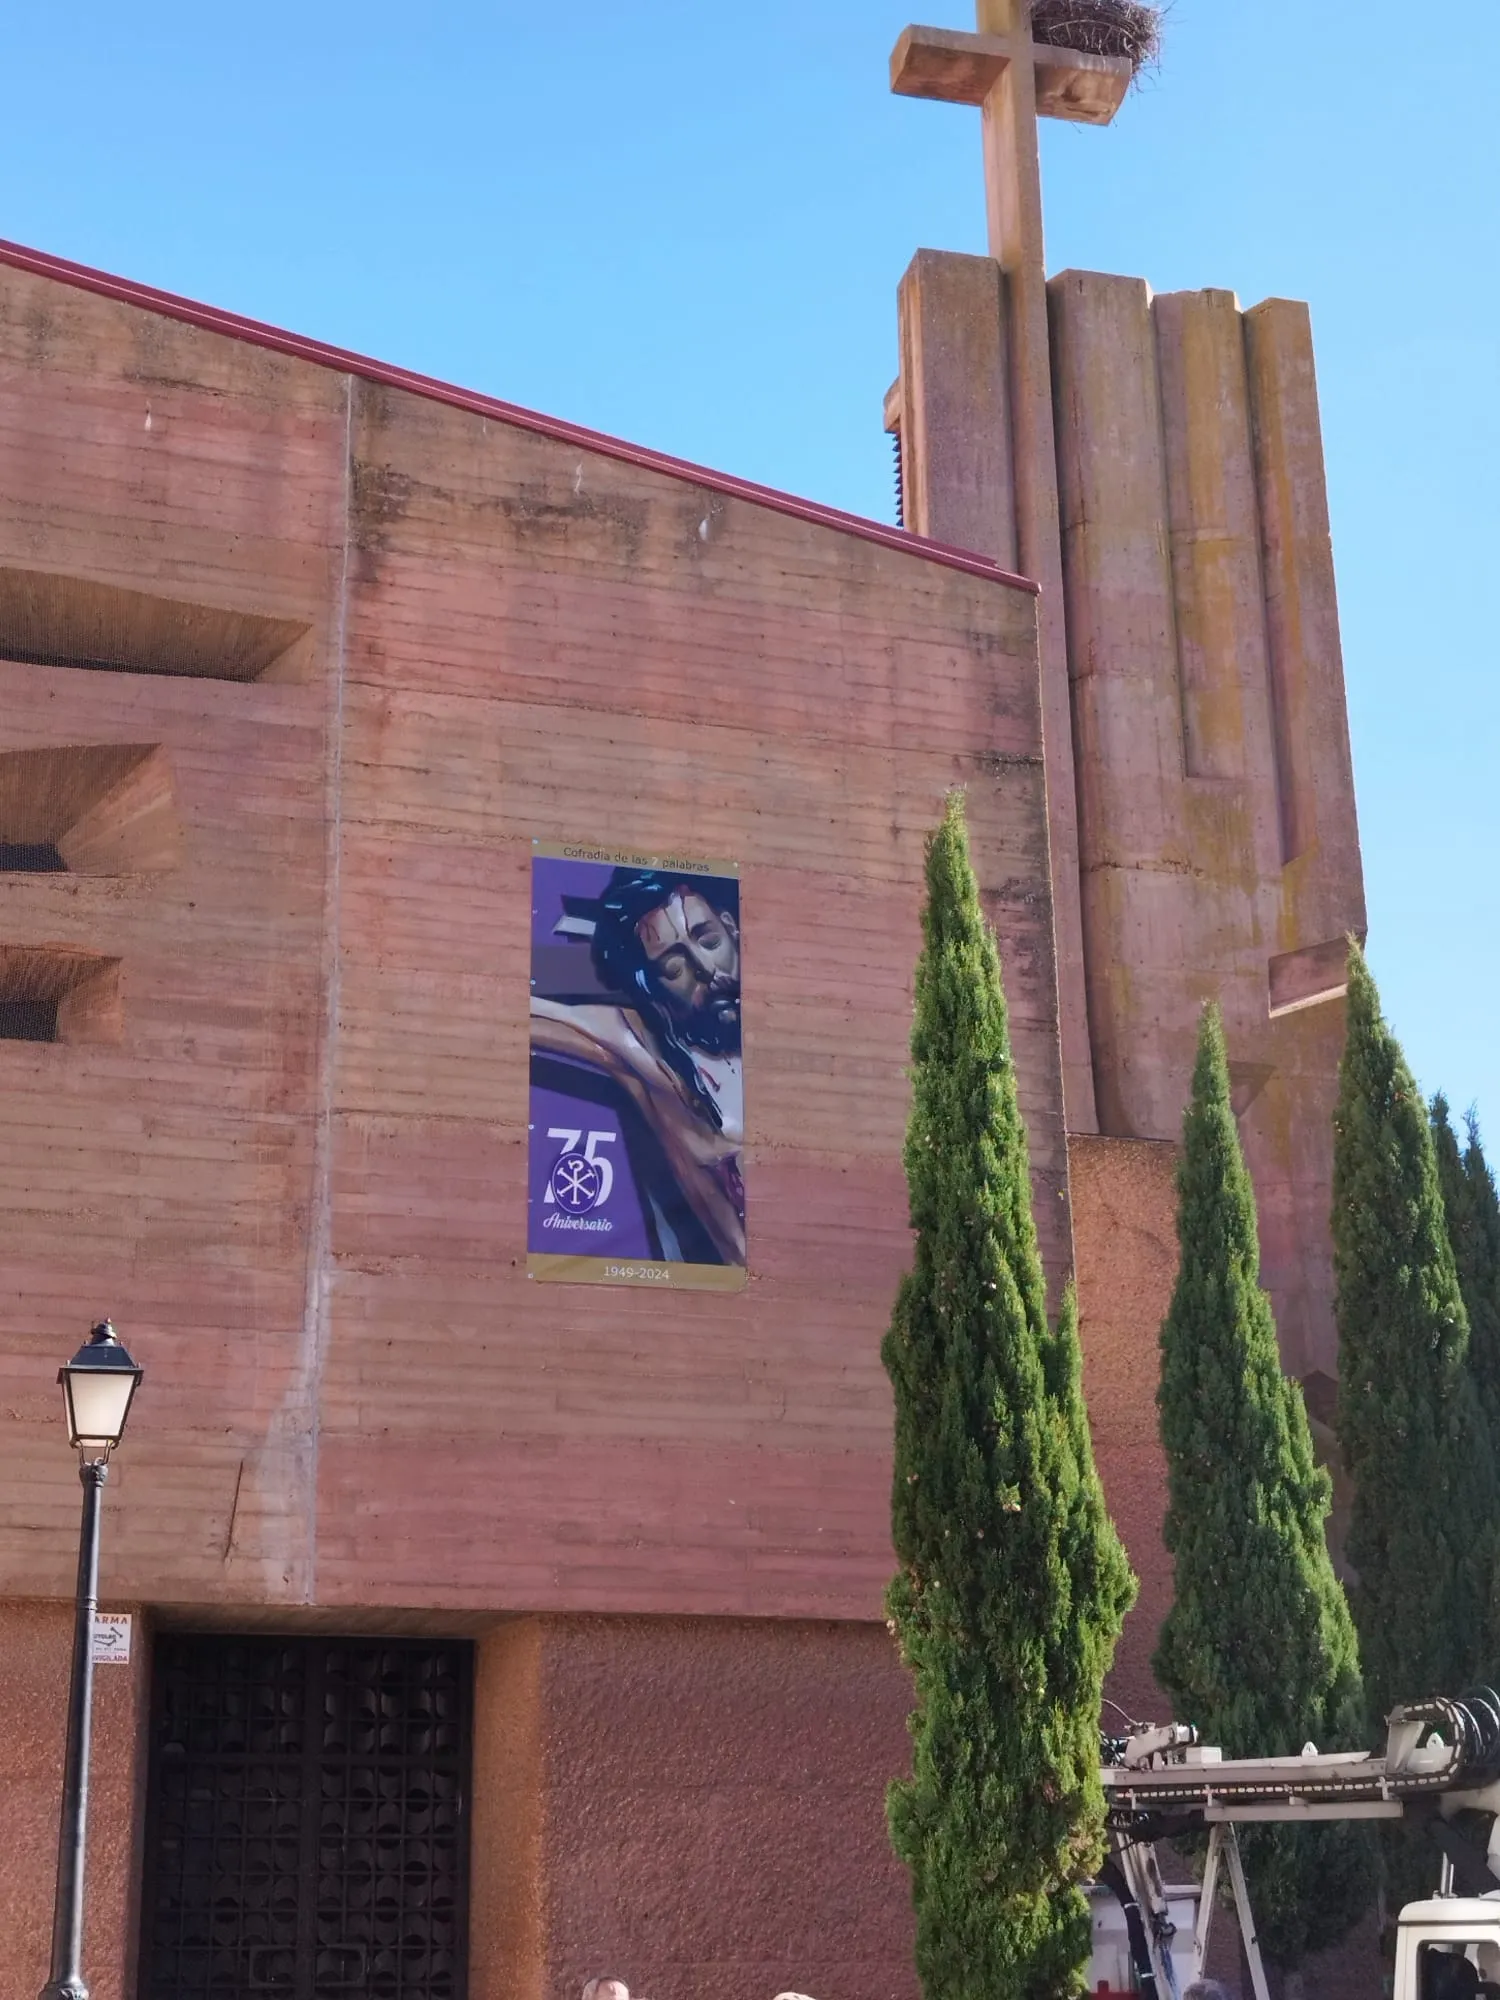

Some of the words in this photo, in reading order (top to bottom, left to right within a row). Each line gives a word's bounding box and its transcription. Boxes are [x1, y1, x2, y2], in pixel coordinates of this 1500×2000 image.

[615, 852, 628, 863] de
[631, 854, 648, 865] las
[651, 856, 658, 866] 7
[662, 859, 710, 872] palabras
[543, 1127, 617, 1208] 75
[543, 1212, 613, 1232] Aniversario
[604, 1266, 670, 1280] 1949-2024
[94, 1616, 128, 1624] ARMA
